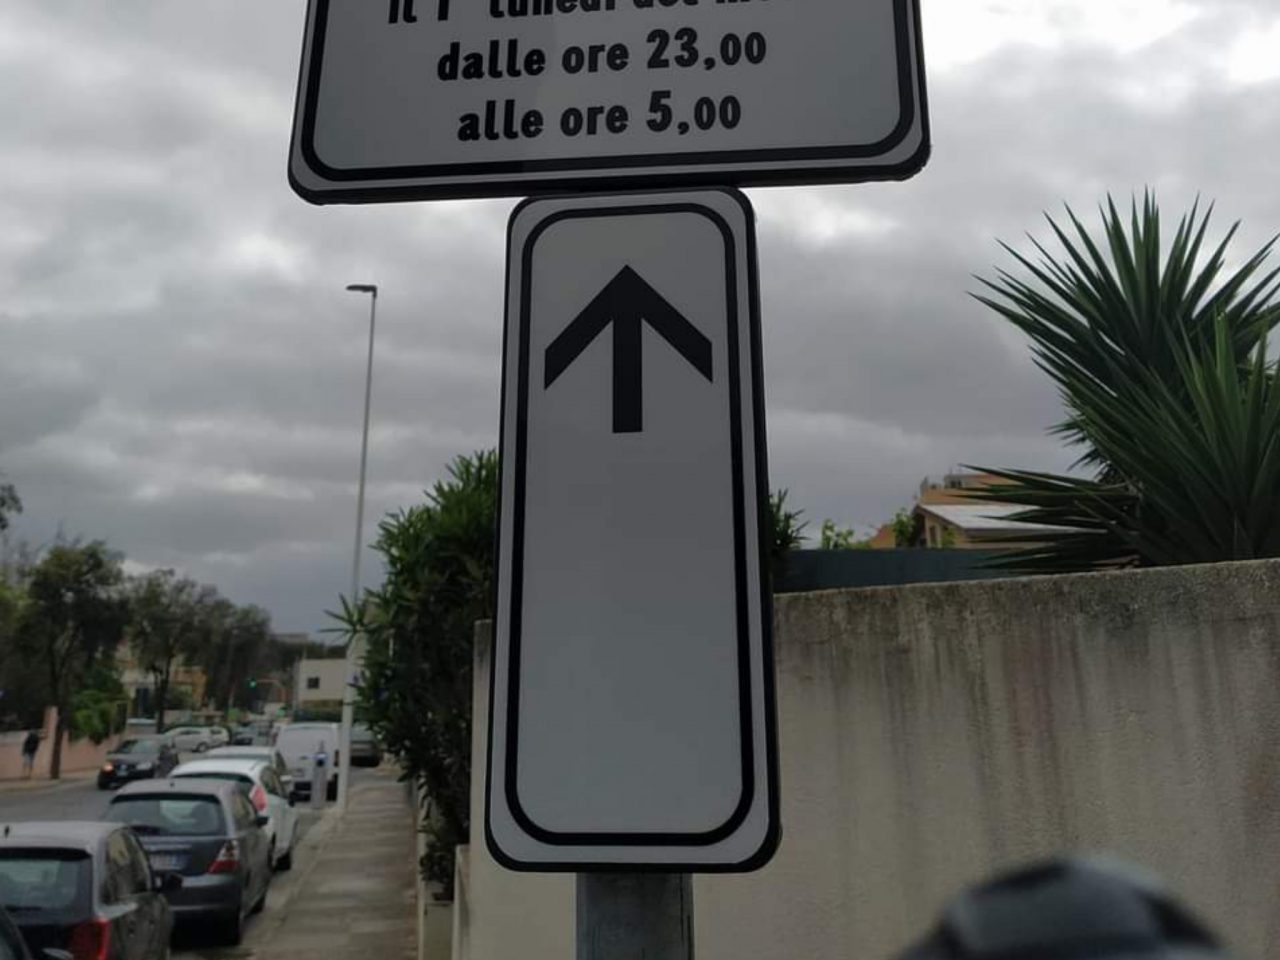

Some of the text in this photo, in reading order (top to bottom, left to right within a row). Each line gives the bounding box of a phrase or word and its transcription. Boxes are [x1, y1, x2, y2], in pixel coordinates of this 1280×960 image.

[438, 27, 767, 81] dalle ore 23,00
[458, 90, 742, 142] alle ore 5,00
